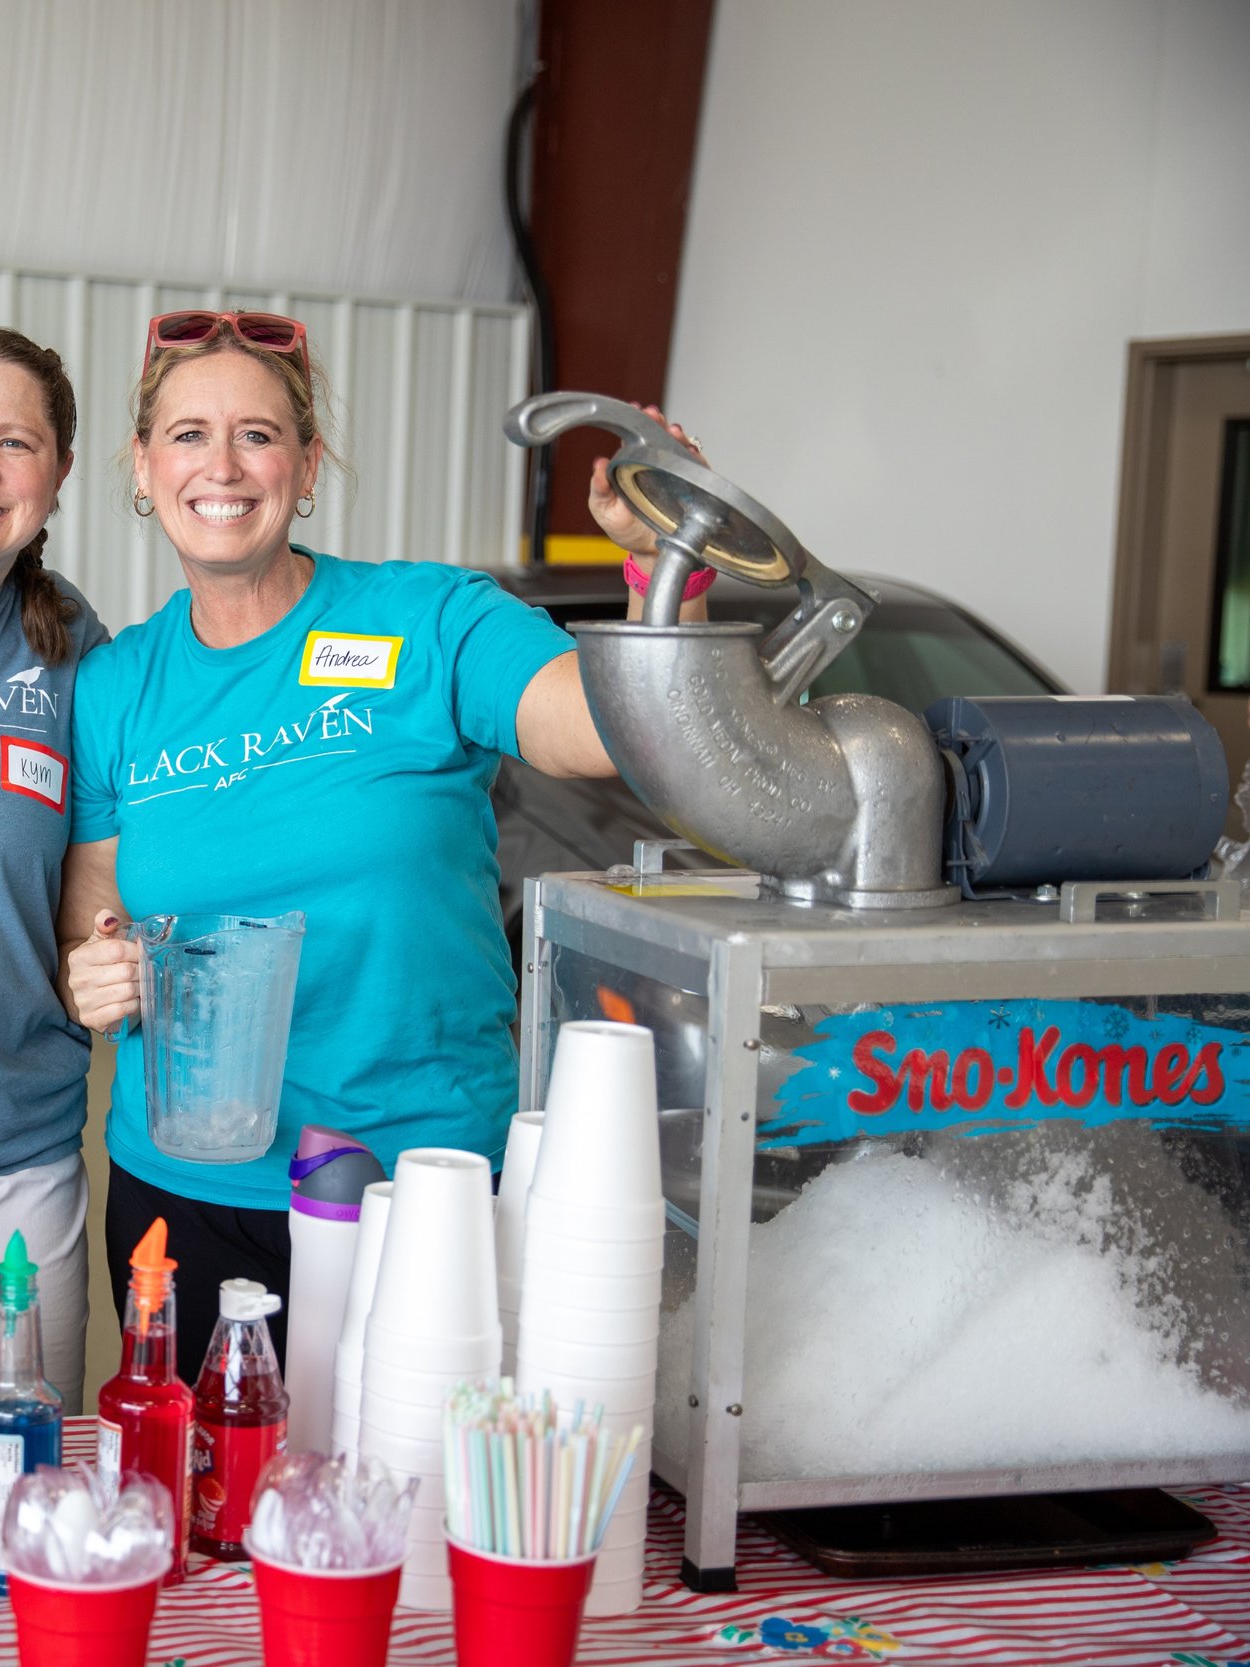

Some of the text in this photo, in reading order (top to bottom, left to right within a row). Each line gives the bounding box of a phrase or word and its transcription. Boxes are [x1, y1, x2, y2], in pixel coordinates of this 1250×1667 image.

[315, 644, 380, 668] Andrea
[128, 708, 373, 786] LACK RAVEN
[667, 689, 717, 770] CINCINNATI
[719, 775, 742, 797] OH
[689, 674, 715, 717] GOLD
[709, 719, 744, 769] MEDAL
[214, 768, 249, 791] AFC
